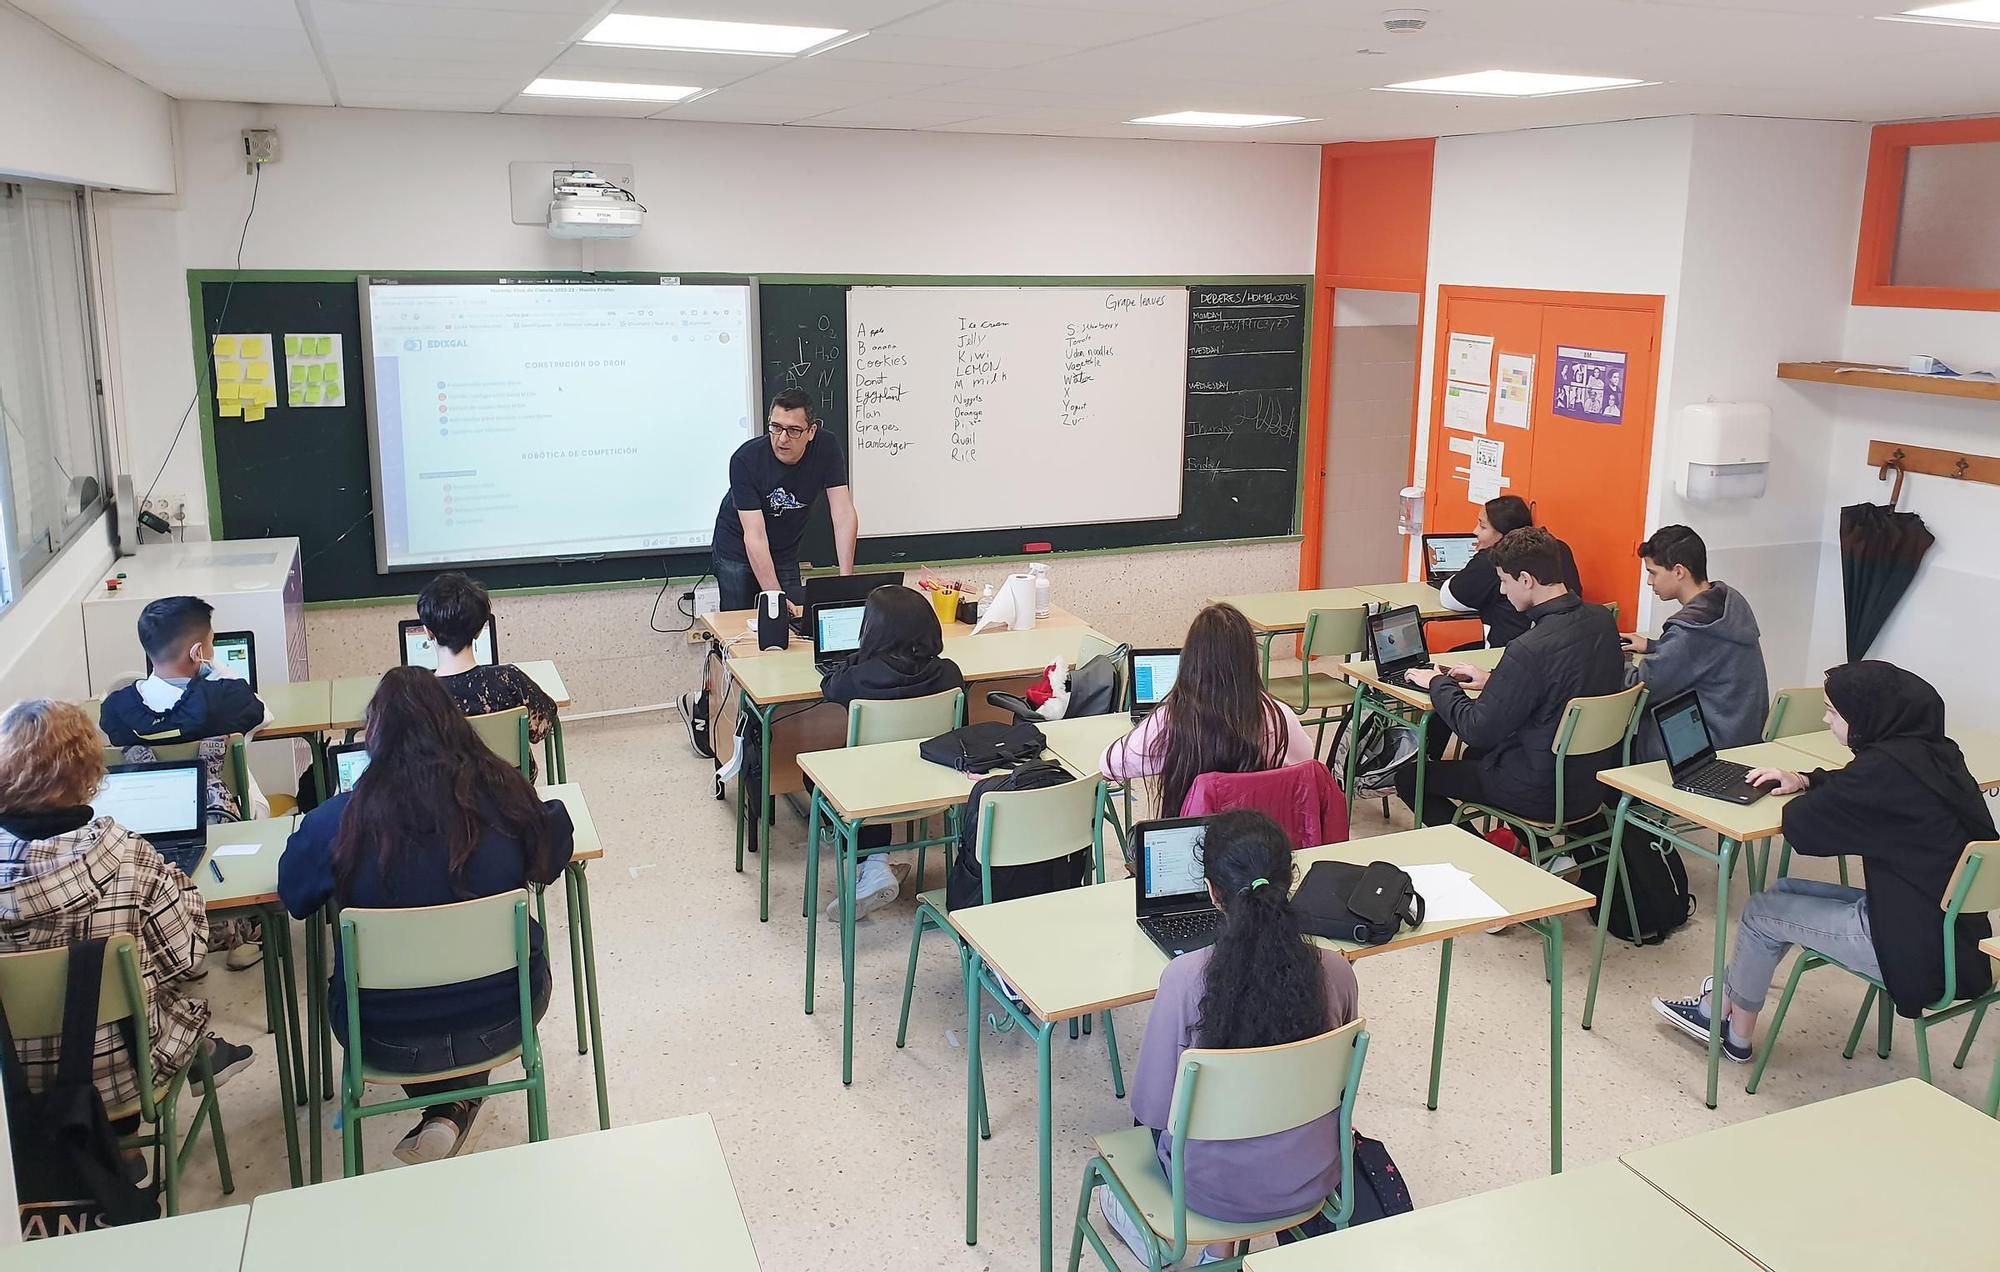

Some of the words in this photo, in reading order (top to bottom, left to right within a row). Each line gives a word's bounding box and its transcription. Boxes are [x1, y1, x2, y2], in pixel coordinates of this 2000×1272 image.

[1105, 294, 1136, 312] Grape
[1140, 294, 1165, 307] leaves
[427, 339, 468, 349] EDIXGAL
[857, 355, 908, 370] Cookies
